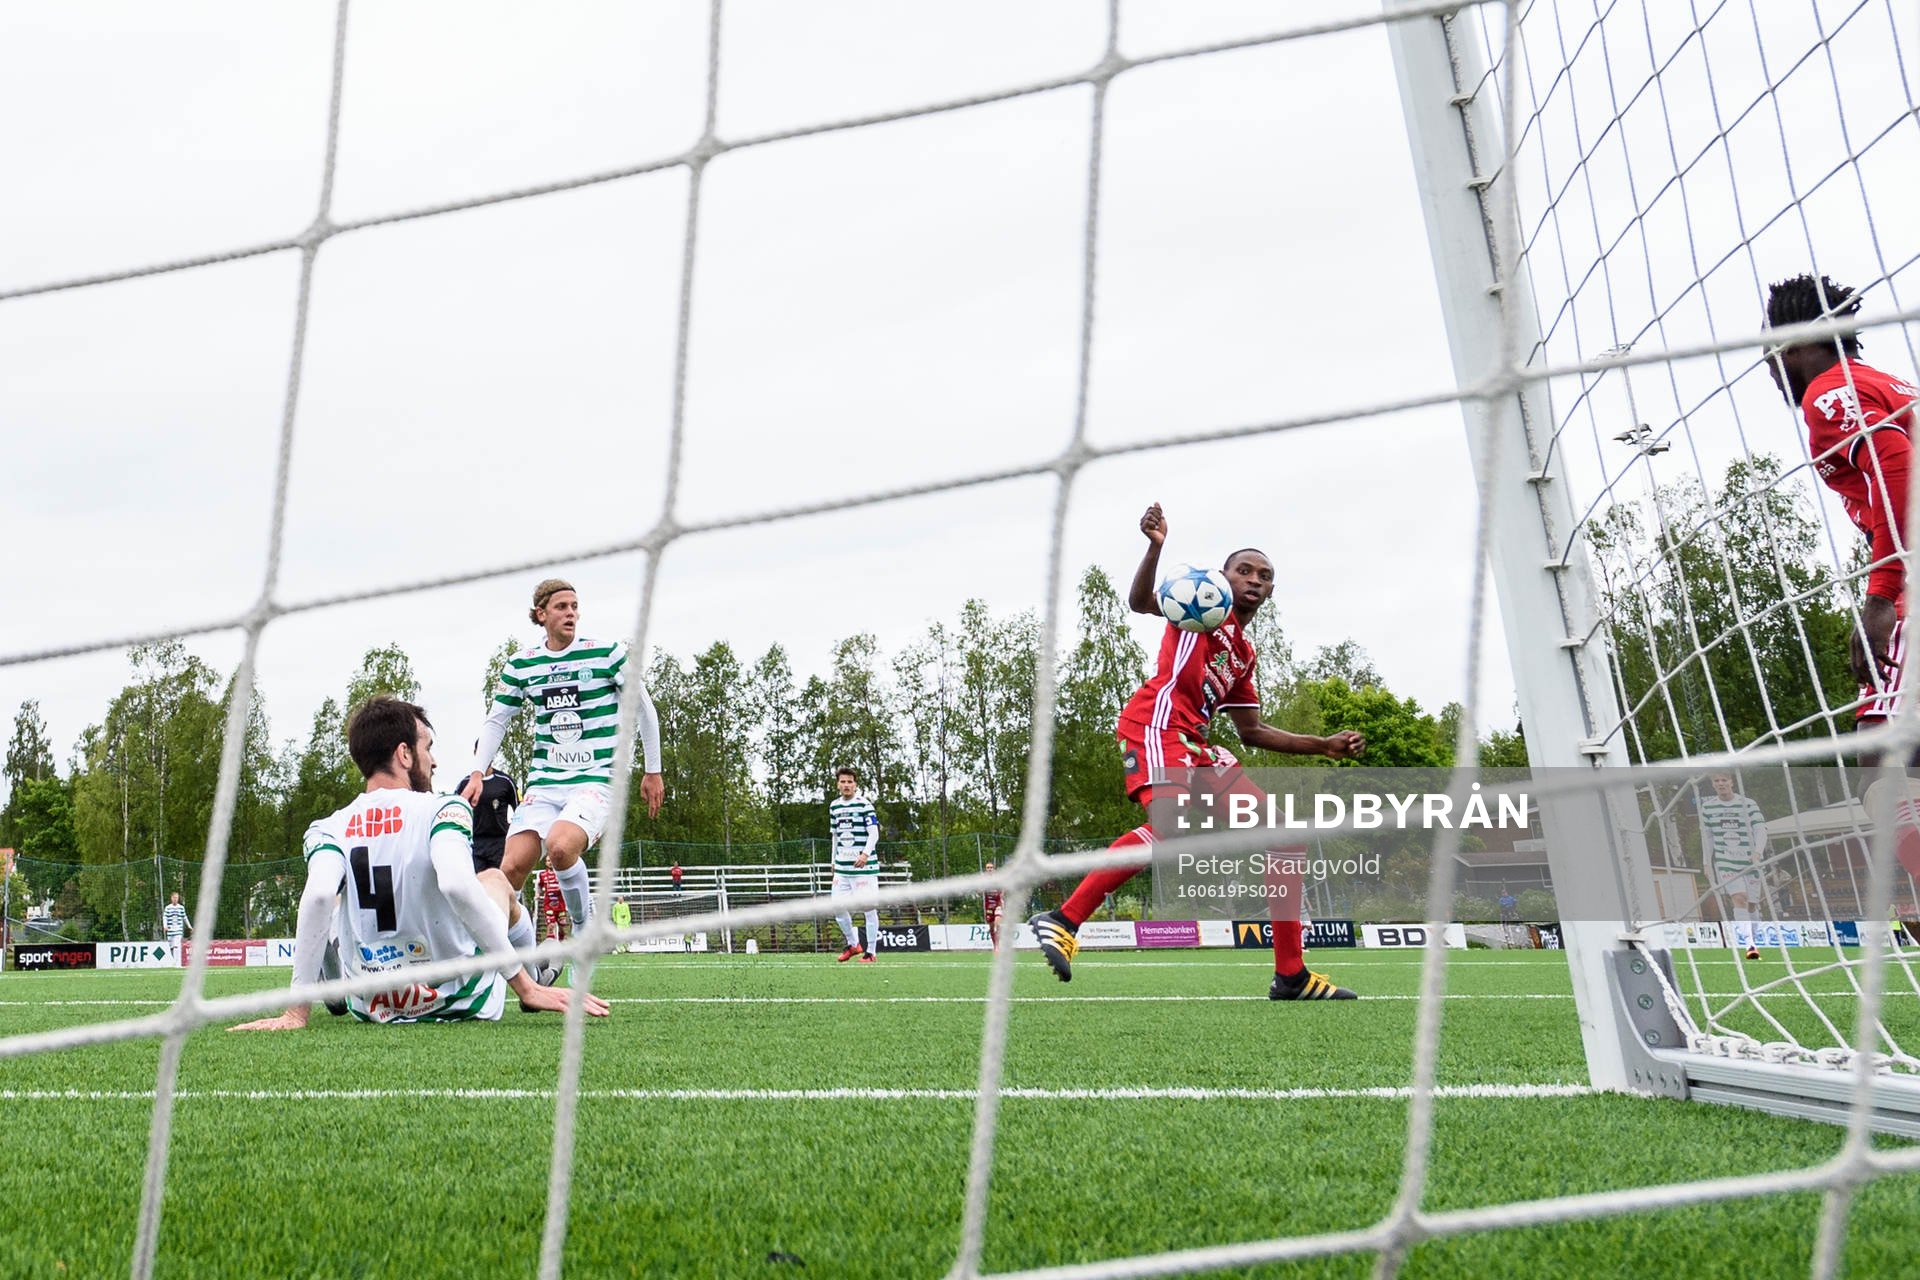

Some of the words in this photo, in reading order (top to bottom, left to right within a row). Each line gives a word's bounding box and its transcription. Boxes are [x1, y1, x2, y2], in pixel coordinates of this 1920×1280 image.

[547, 694, 578, 709] ABAX
[345, 806, 404, 838] ABB
[350, 846, 398, 932] 4
[875, 929, 917, 947] Piteå
[1140, 926, 1196, 935] Hemmabanken
[19, 950, 92, 966] sportringen
[370, 983, 438, 1014] AVIS
